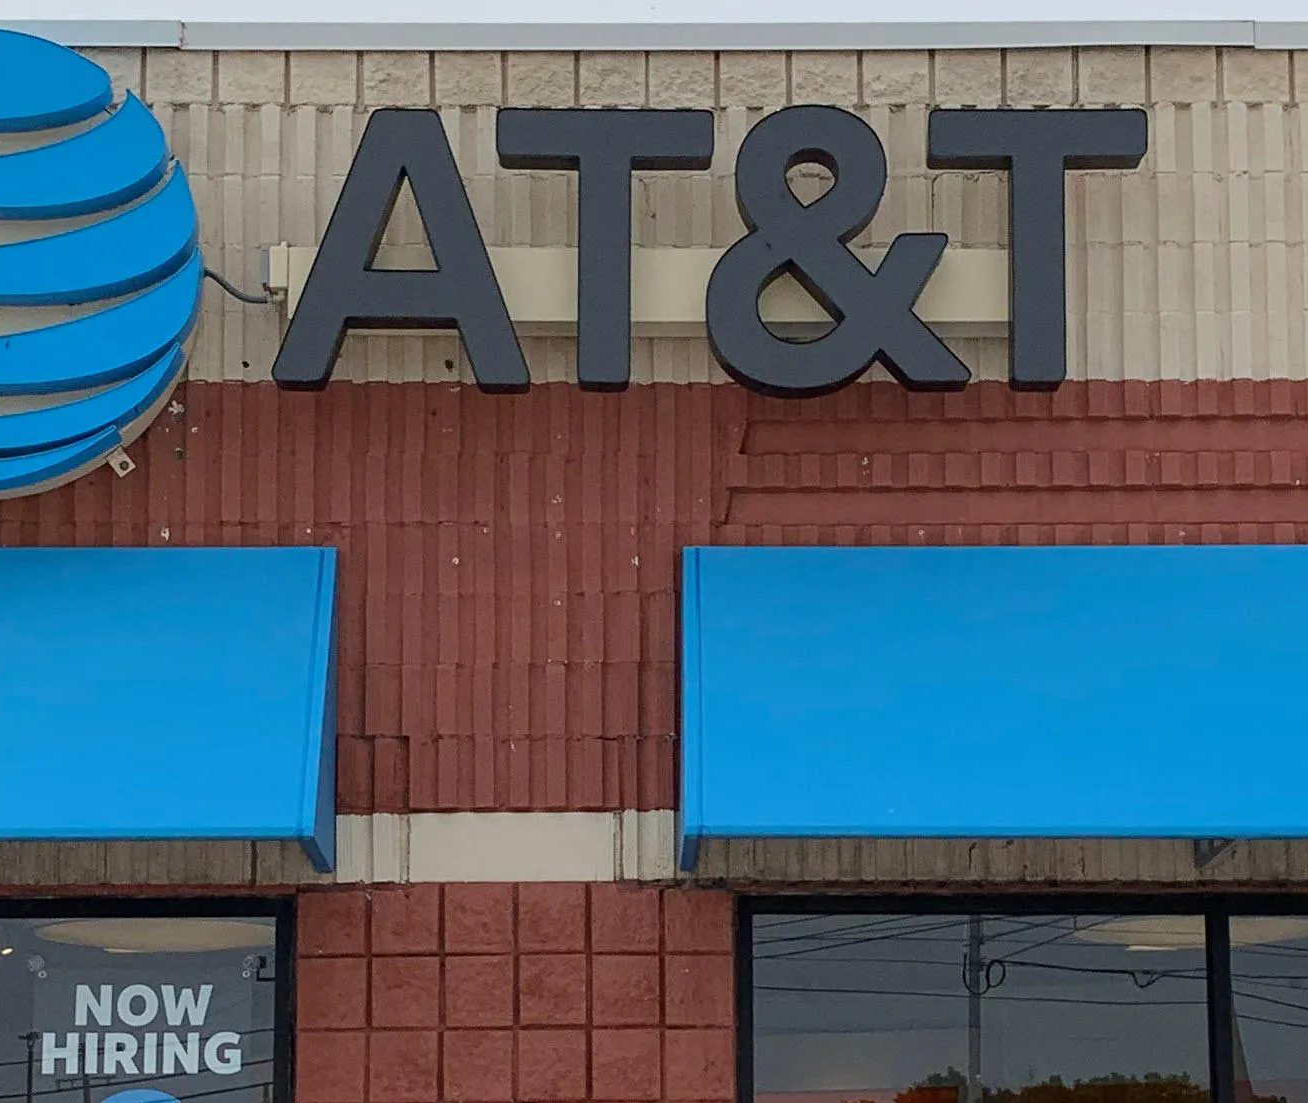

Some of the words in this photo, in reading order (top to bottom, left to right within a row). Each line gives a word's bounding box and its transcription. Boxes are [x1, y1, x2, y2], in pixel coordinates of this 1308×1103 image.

[271, 104, 1149, 398] AT&T
[74, 983, 214, 1027] NOW
[40, 1031, 243, 1075] HIRING
